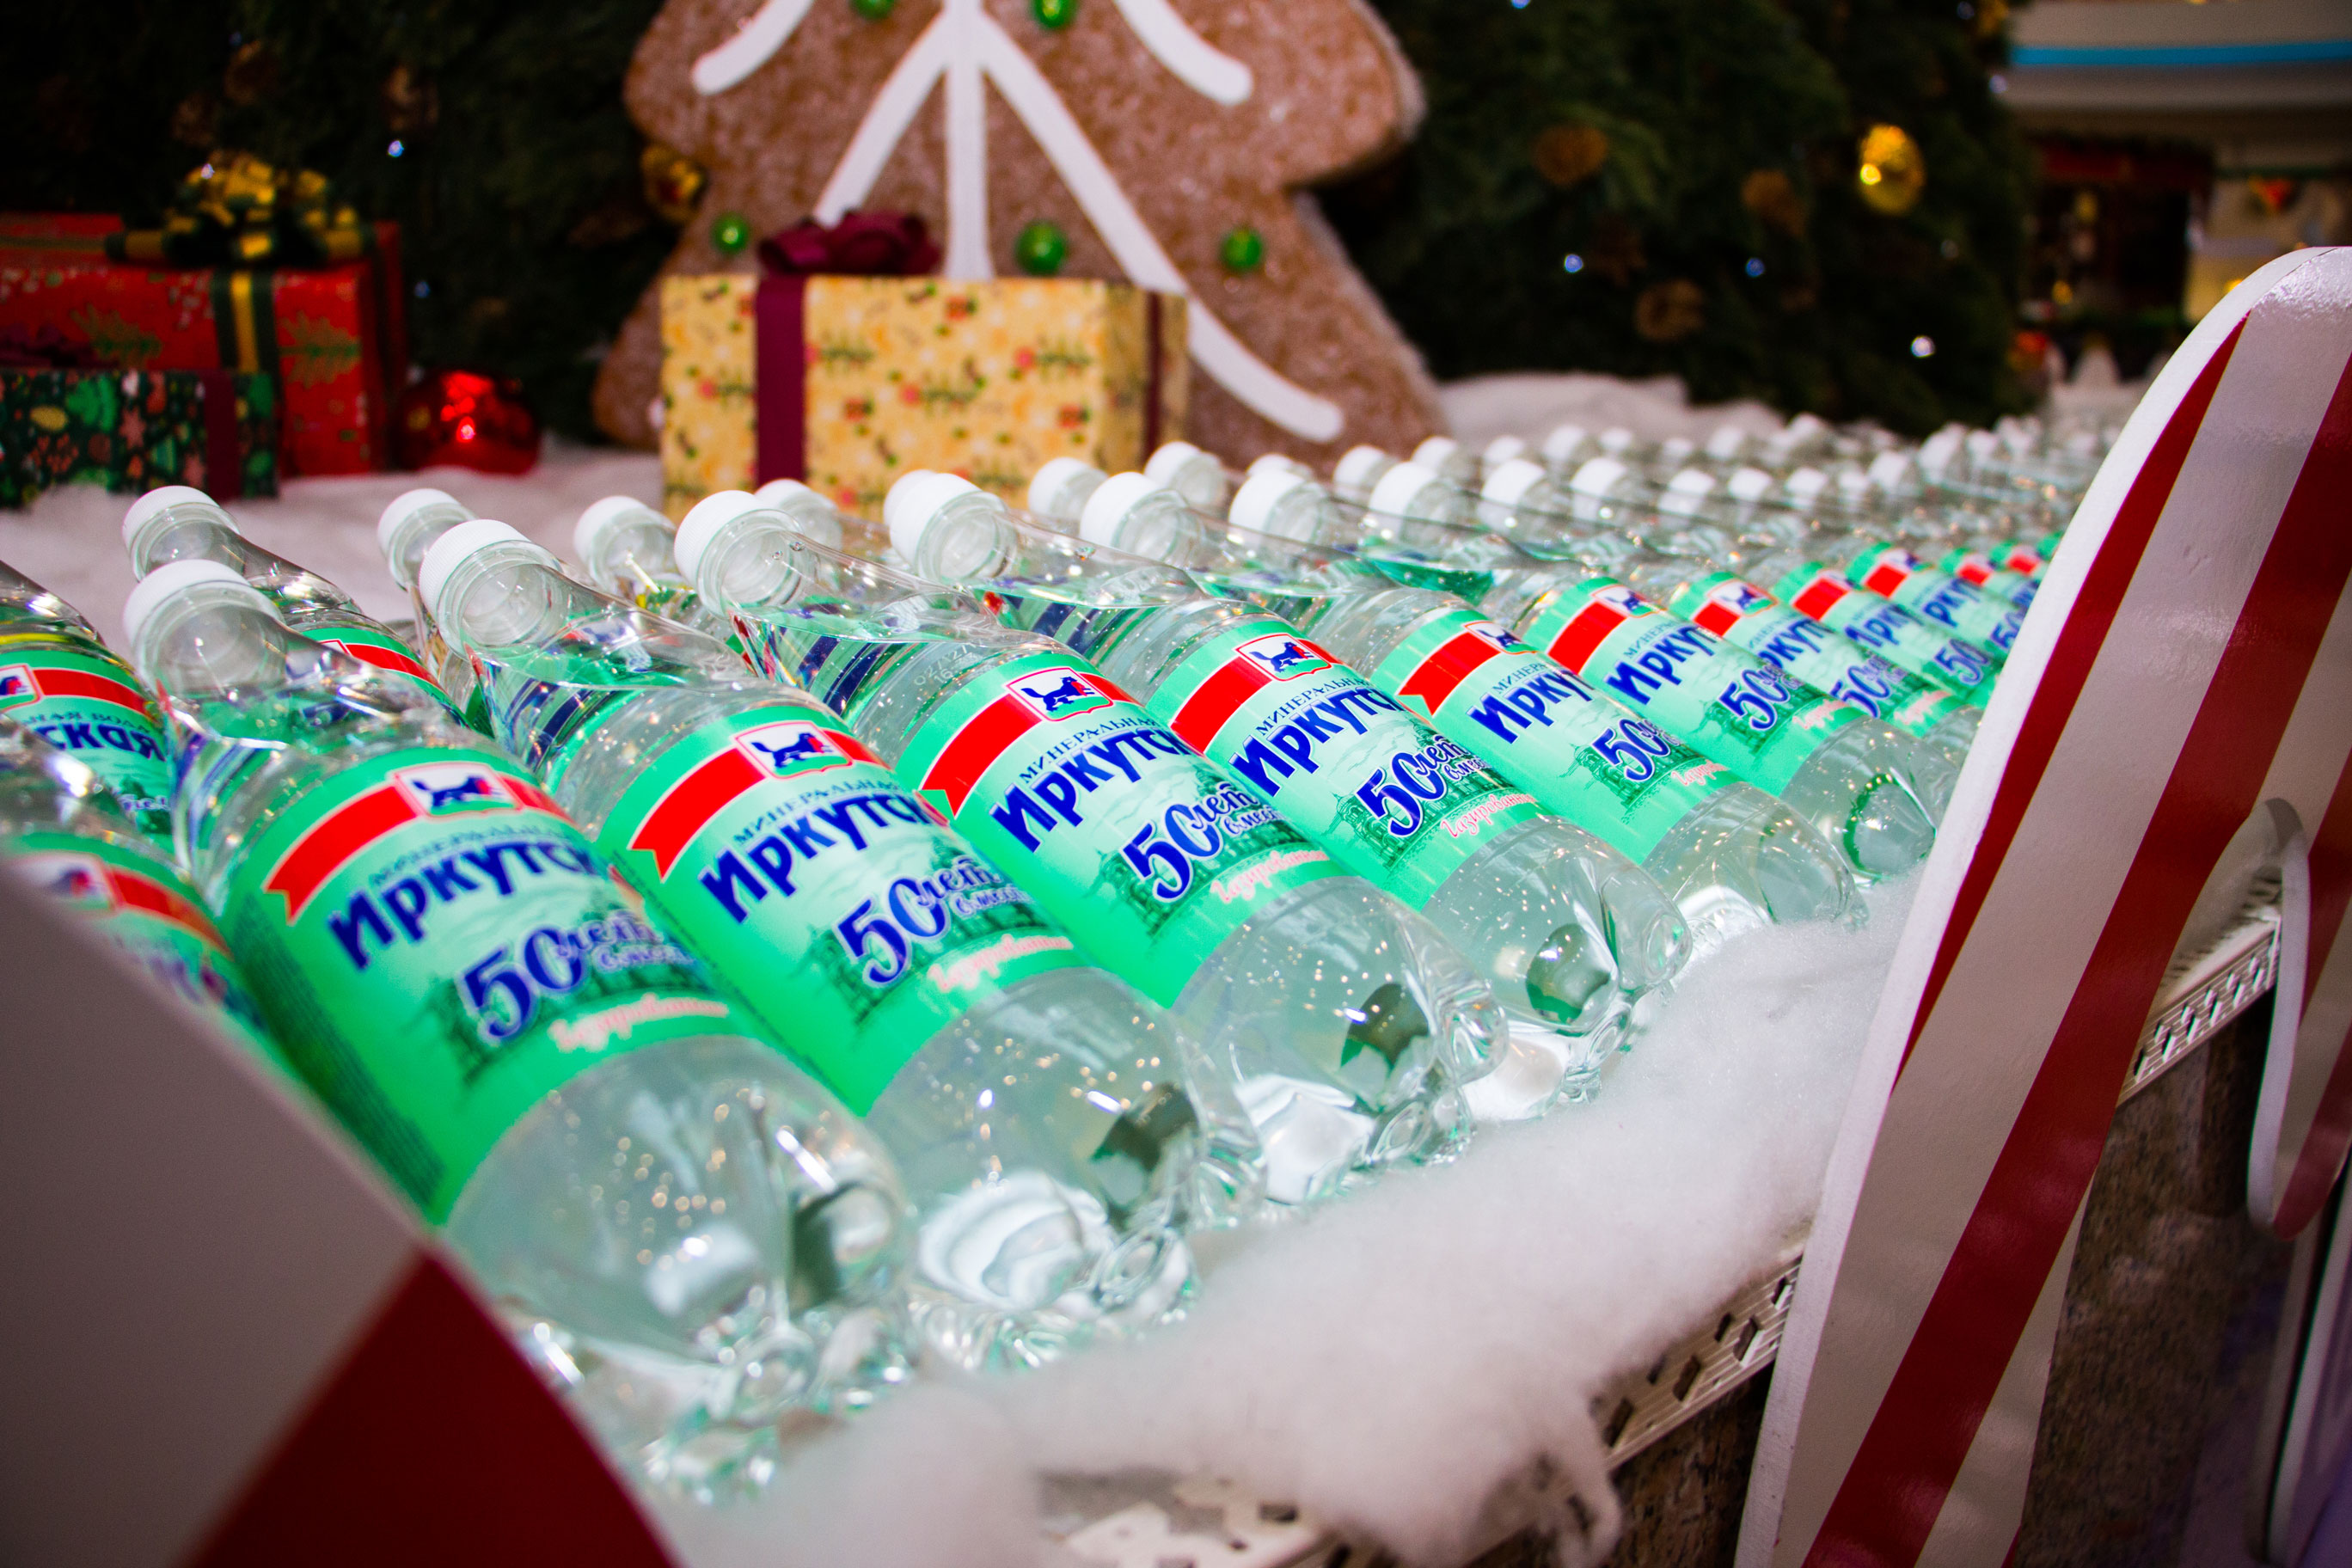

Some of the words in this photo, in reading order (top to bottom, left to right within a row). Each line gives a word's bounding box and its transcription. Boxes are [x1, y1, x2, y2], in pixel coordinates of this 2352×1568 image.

[1718, 669, 1791, 730] 50
[1933, 638, 1988, 685] 50
[1592, 719, 1670, 781] 50
[1356, 752, 1446, 836] 50
[1122, 804, 1222, 900] 50
[837, 877, 948, 984] 50
[462, 926, 584, 1038] 50
